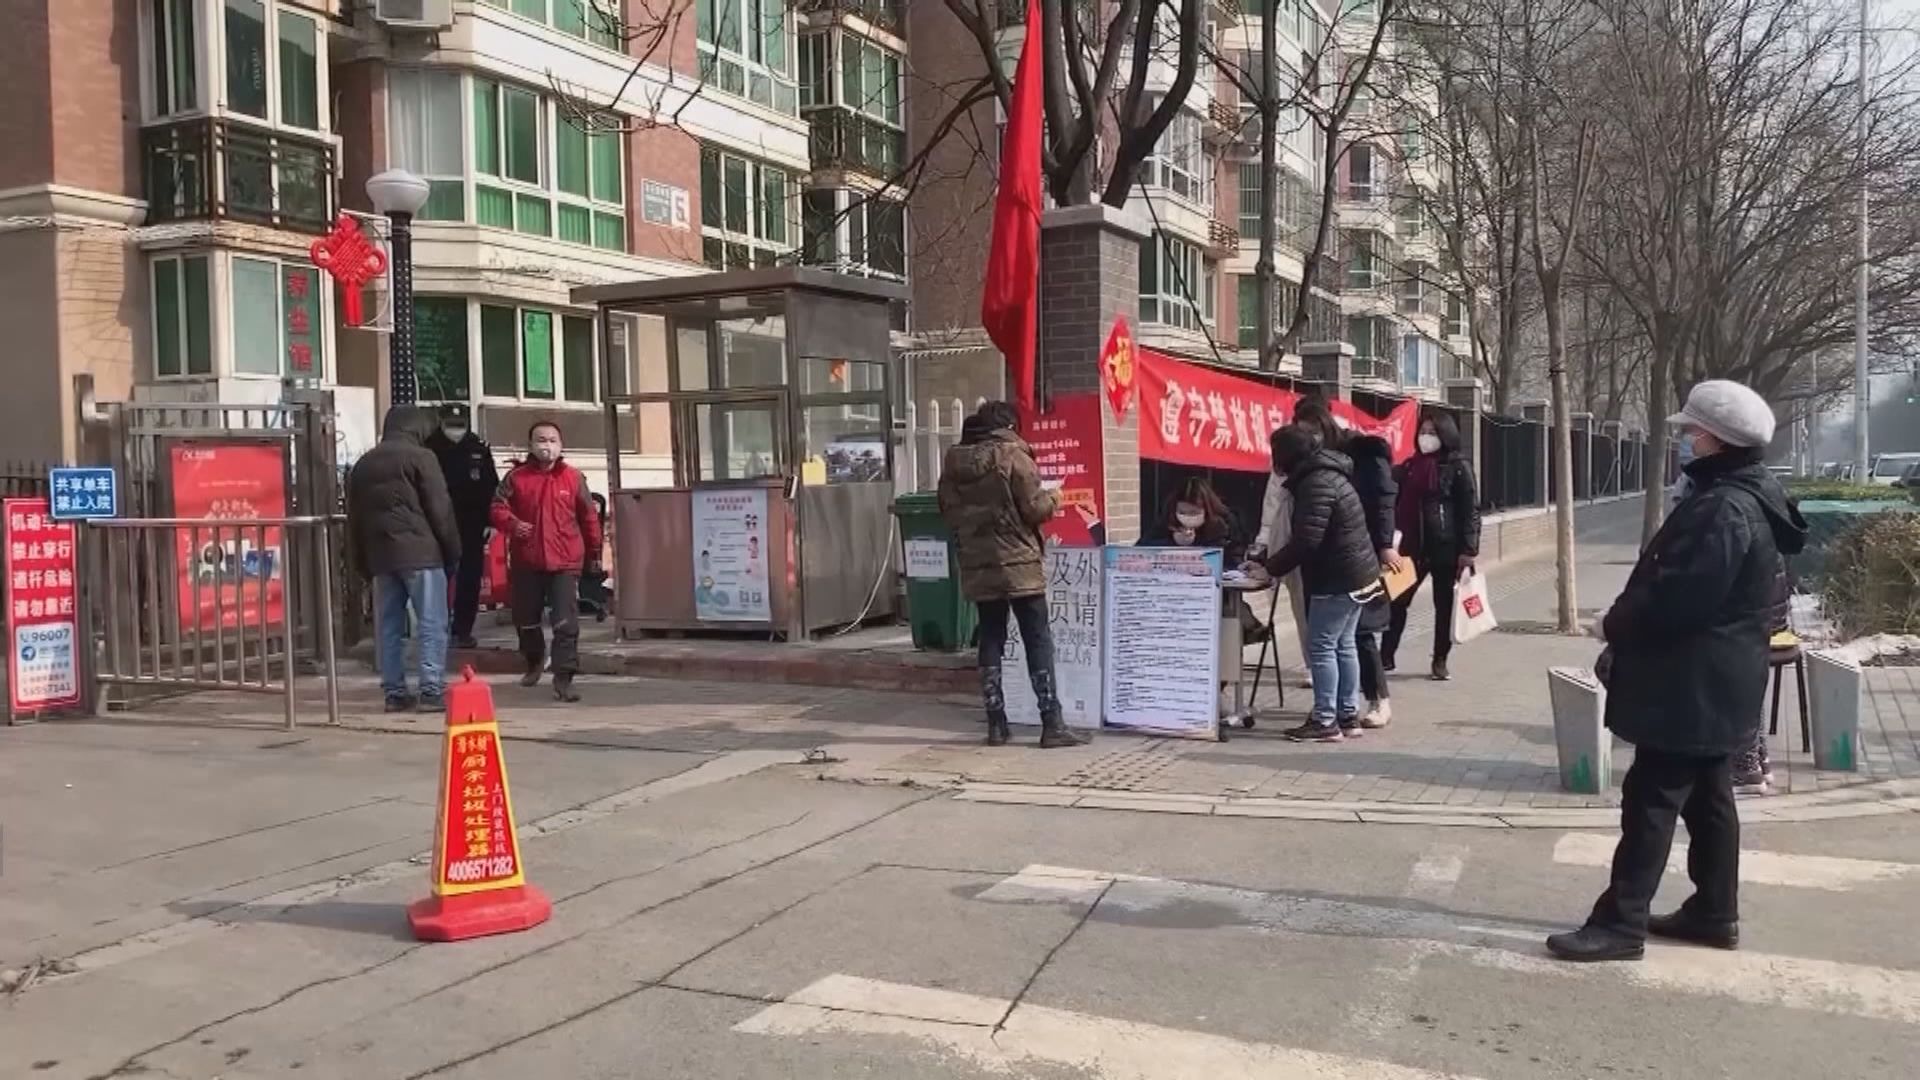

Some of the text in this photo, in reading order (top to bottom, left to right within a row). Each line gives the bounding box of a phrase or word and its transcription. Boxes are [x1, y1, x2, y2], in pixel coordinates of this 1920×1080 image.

[675, 196, 686, 222] 5
[56, 477, 111, 492] 共享单车
[56, 495, 112, 510] 禁止入院
[12, 540, 71, 560] 禁止穿行
[1050, 551, 1098, 587] 及外
[1050, 590, 1098, 627] 员请
[31, 628, 70, 642] 96007
[448, 857, 513, 881] 4006571282
